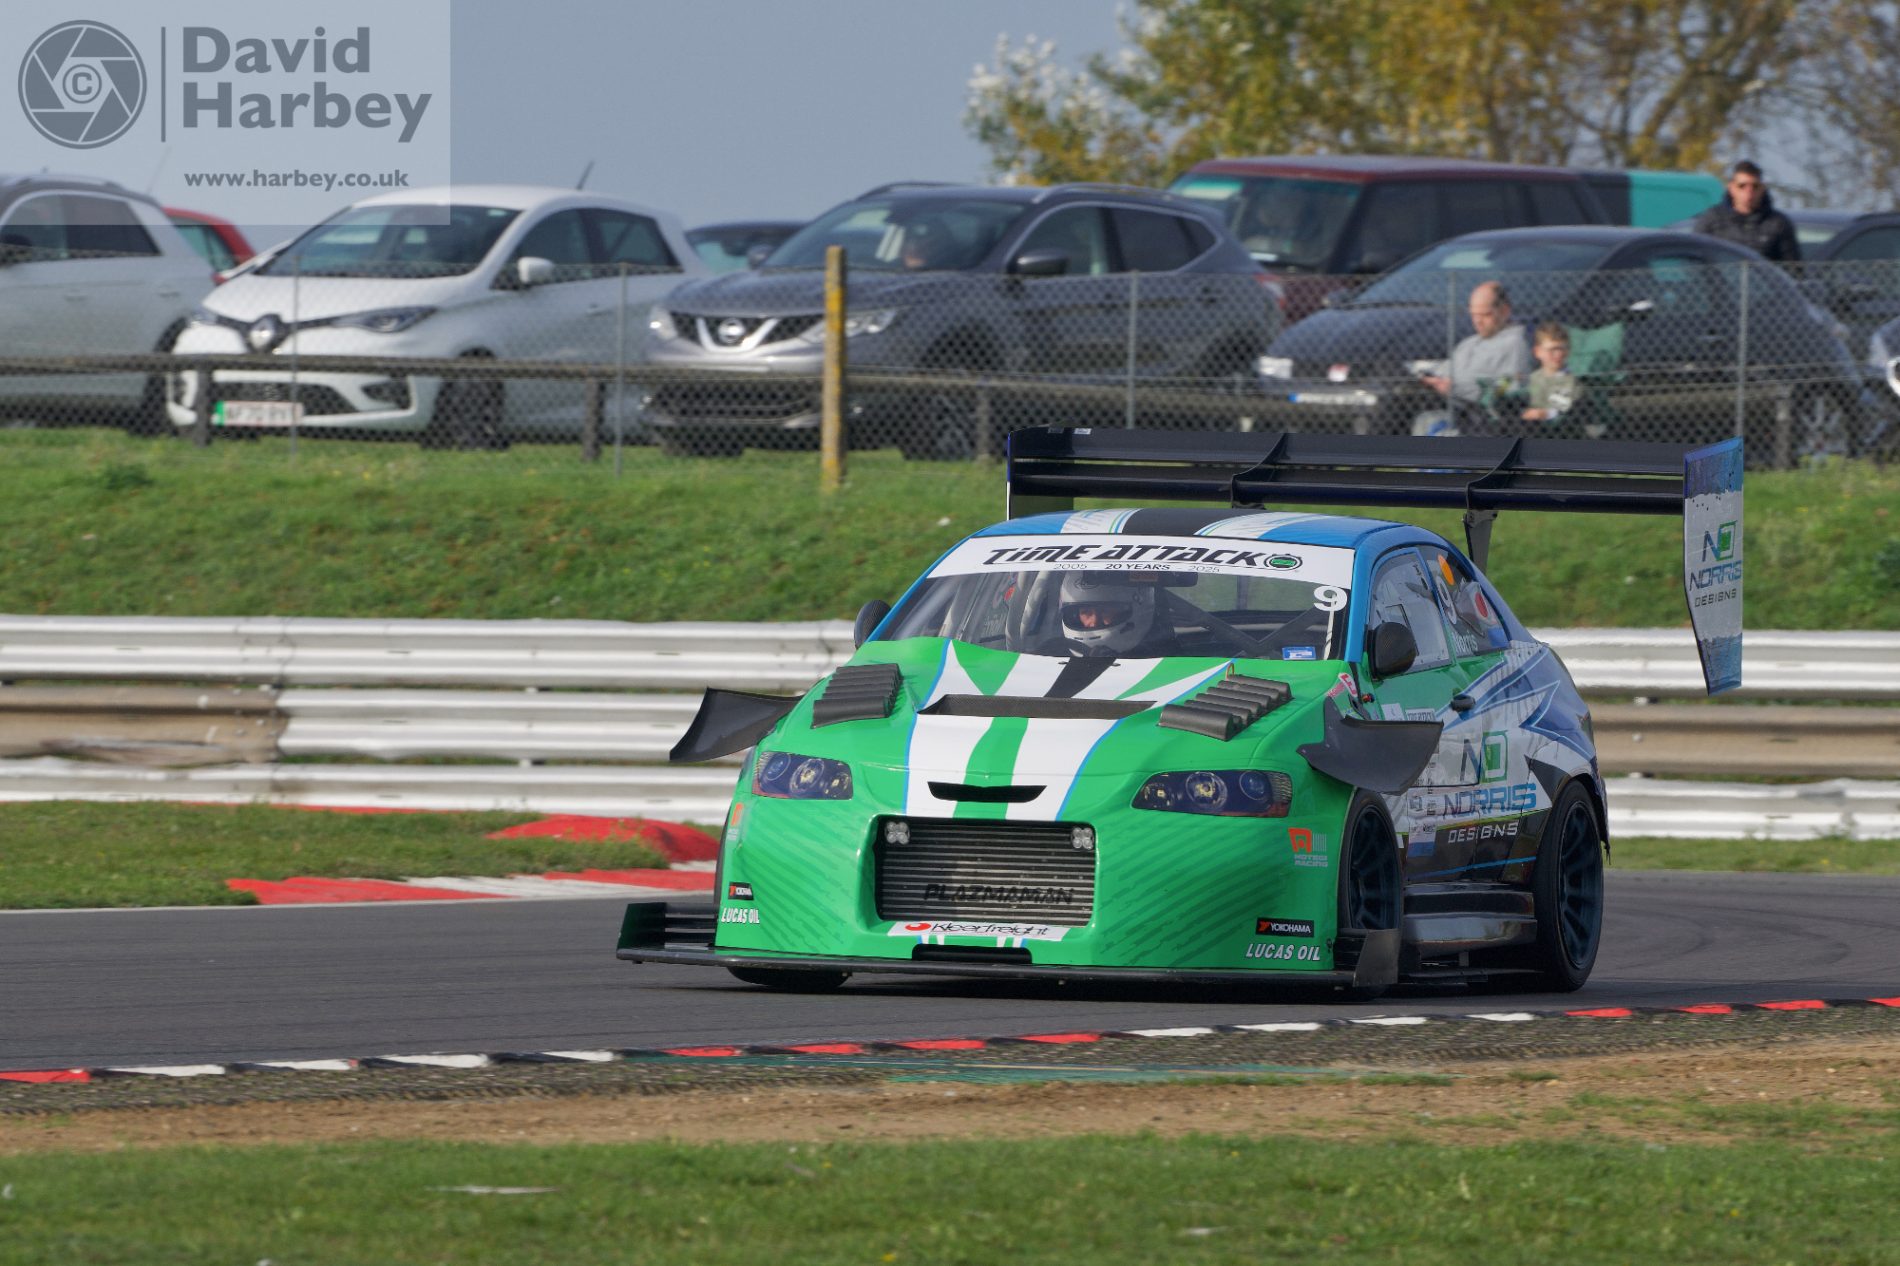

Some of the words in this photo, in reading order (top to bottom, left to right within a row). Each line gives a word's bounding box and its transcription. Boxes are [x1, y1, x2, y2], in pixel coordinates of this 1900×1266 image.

[1092, 544, 1265, 568] ATTACK
[1053, 562, 1088, 570] 2005
[1105, 563, 1123, 571] 20
[1126, 563, 1171, 571] YEARS
[1188, 565, 1221, 573] 2025
[1313, 585, 1347, 611] 9
[1695, 588, 1737, 608] DESIGNS
[1443, 783, 1537, 820] NORRIS
[1448, 822, 1519, 844] DESIGNS
[721, 907, 748, 924] LUCAS
[749, 908, 760, 924] OIL
[1270, 923, 1311, 933] YOKOHAMA
[1246, 943, 1294, 961] LUCAS
[1297, 946, 1320, 961] OIL
